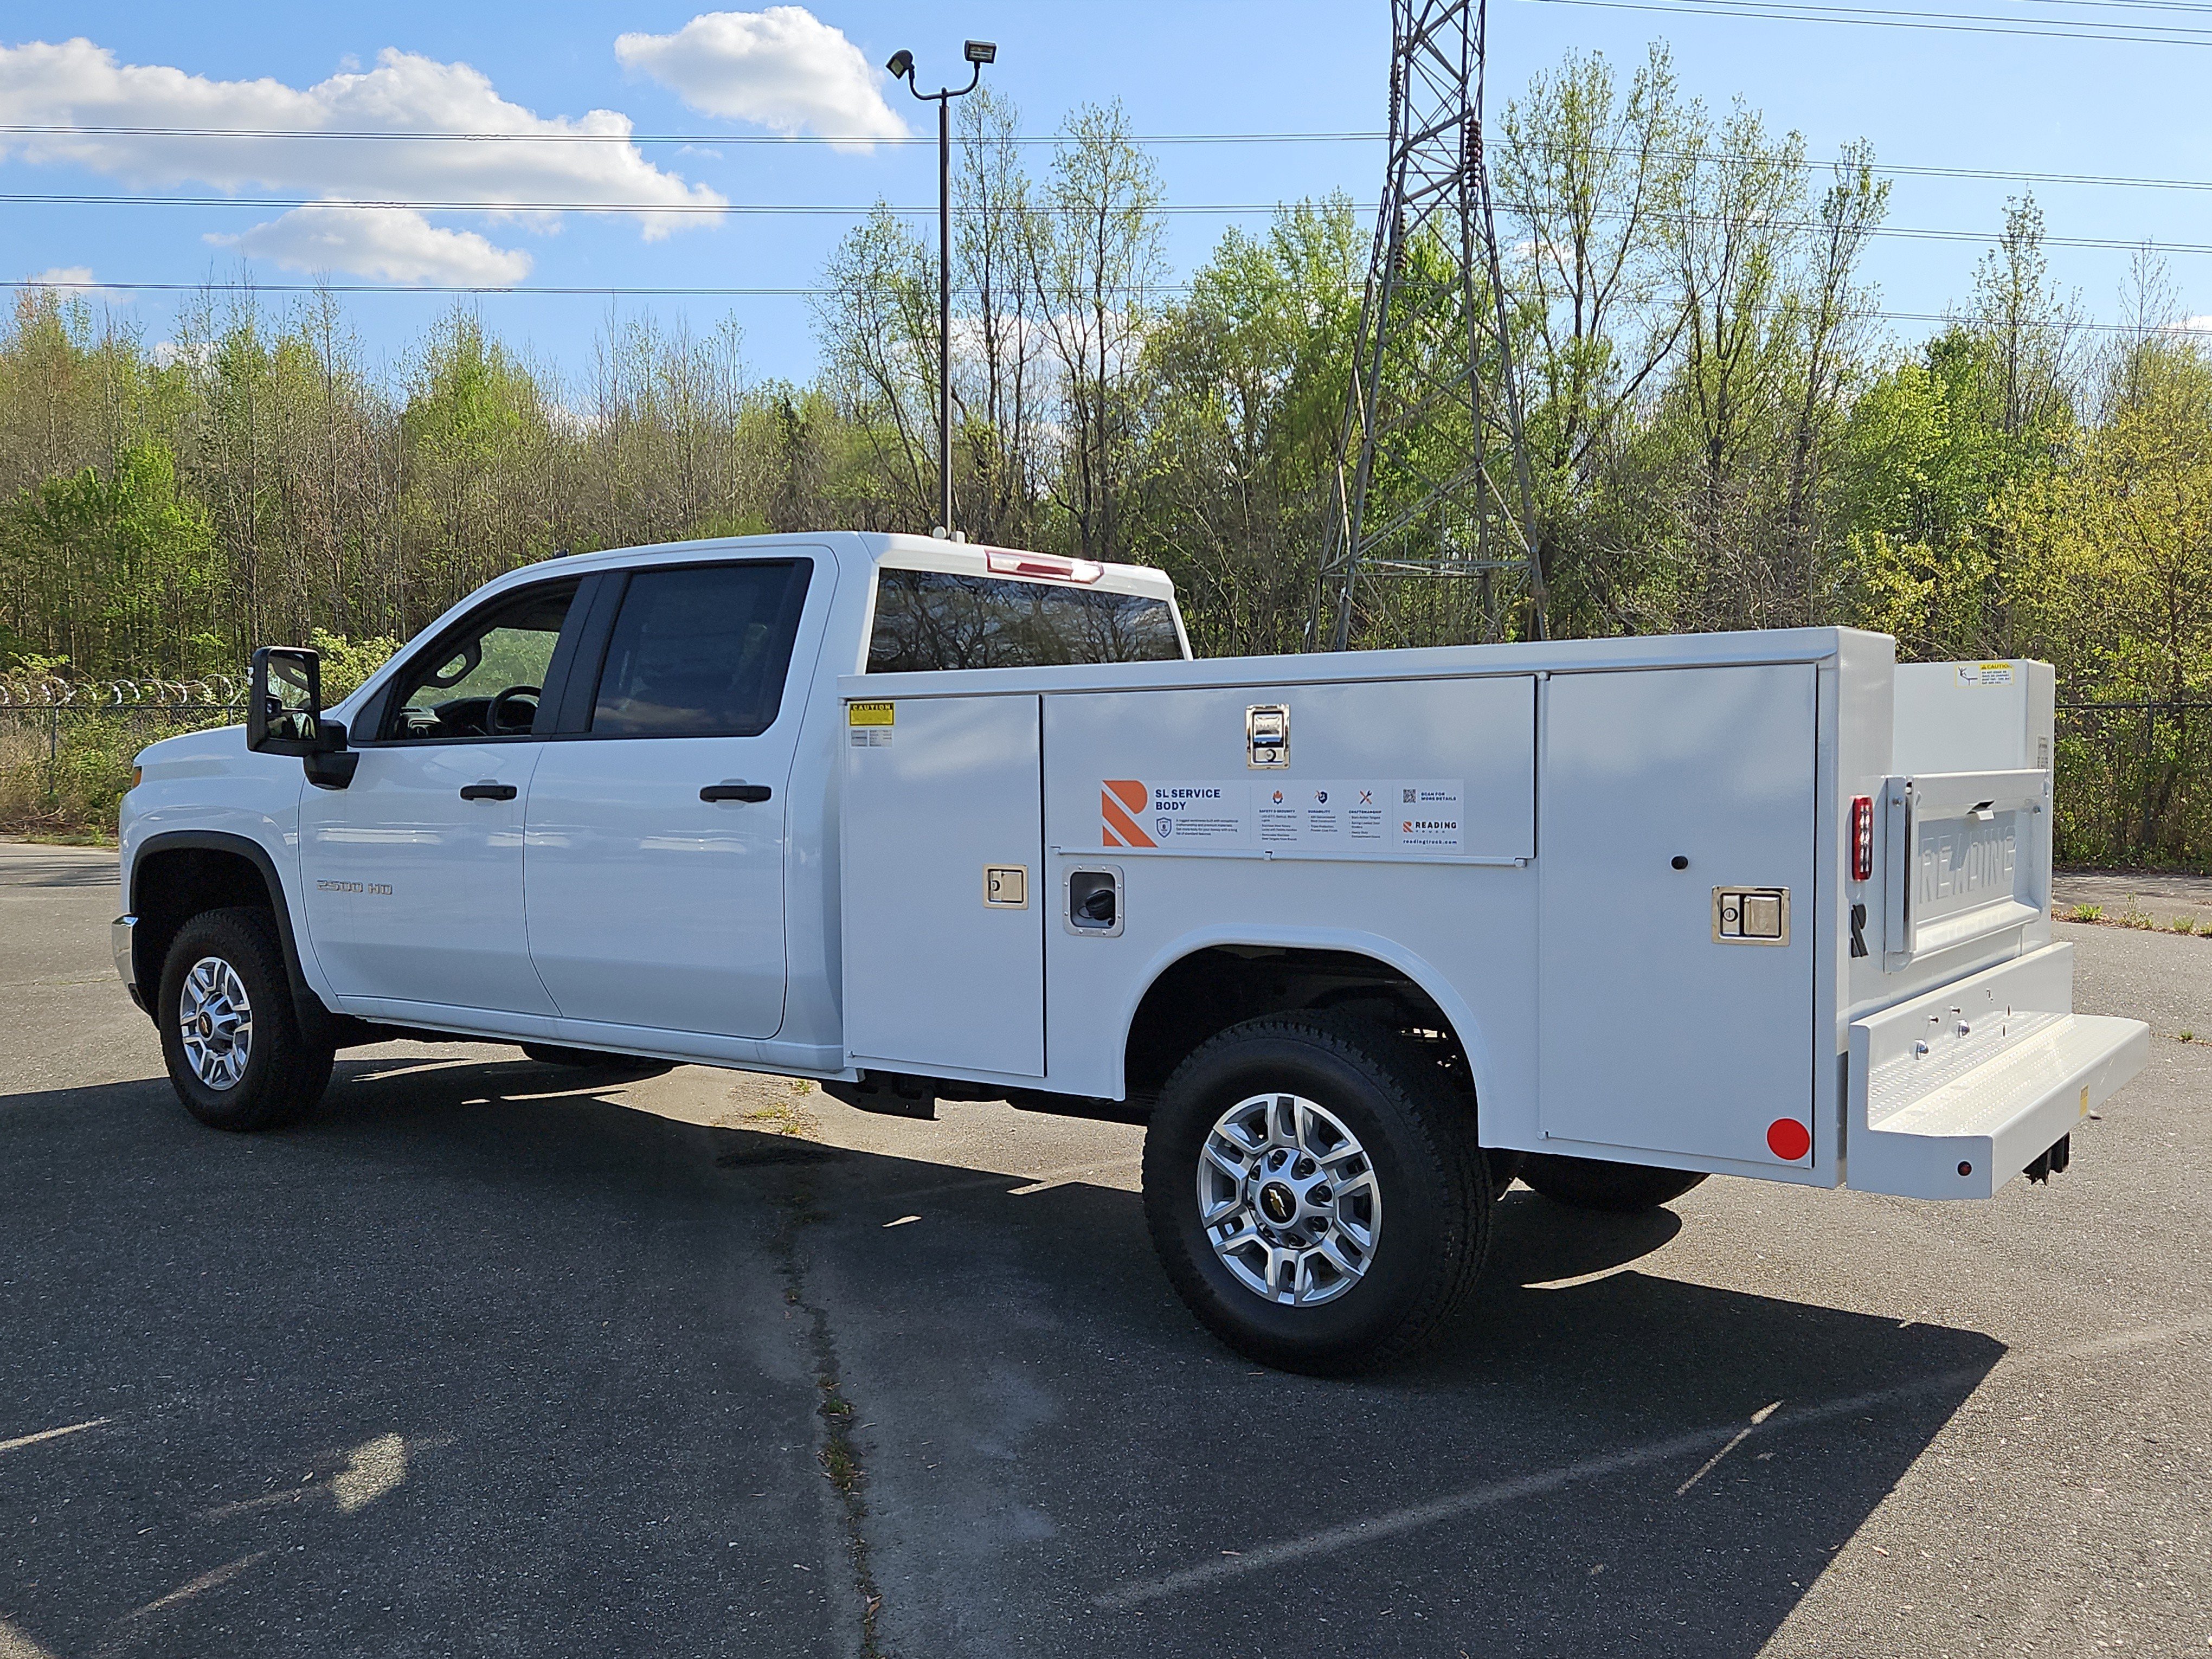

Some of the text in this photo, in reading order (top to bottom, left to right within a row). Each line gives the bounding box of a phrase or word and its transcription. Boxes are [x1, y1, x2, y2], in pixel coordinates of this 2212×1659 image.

[1155, 789, 1220, 798] SL SERVICE
[1156, 802, 1186, 811] BODY
[317, 879, 393, 895] 2500 HD
